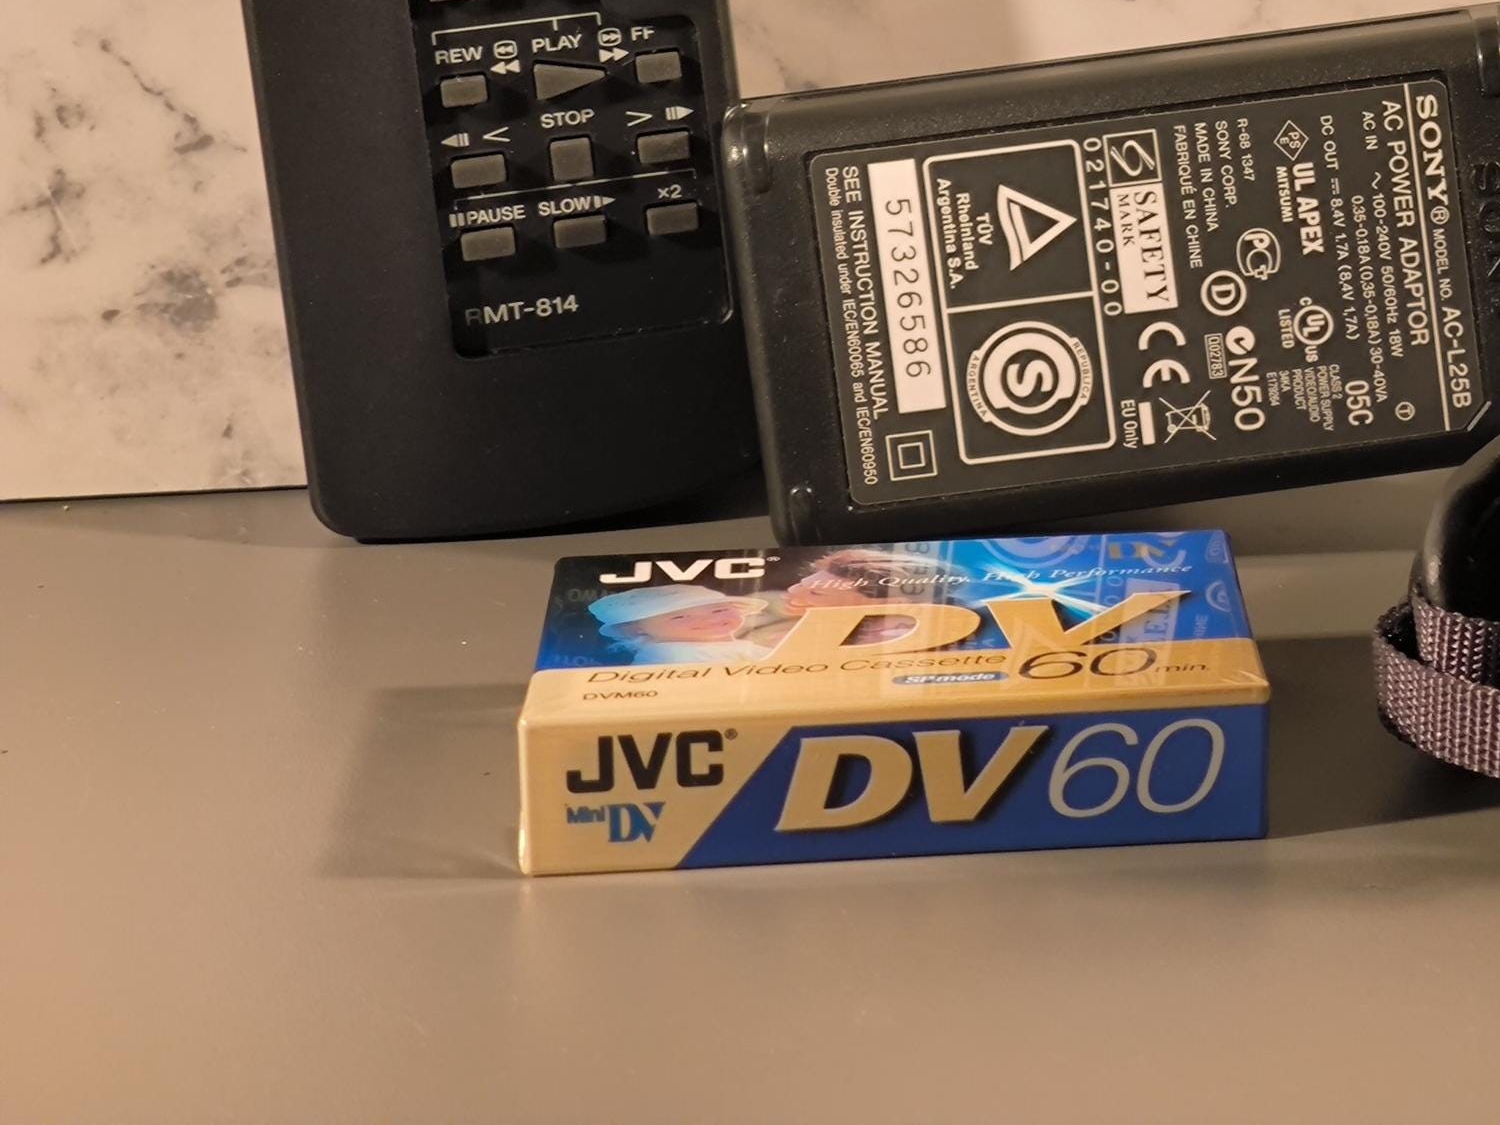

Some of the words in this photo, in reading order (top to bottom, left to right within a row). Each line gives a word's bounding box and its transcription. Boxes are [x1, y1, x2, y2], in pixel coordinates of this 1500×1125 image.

[532, 35, 582, 53] PLAY
[631, 27, 654, 41] FF
[435, 46, 482, 64] REW
[541, 109, 595, 128] STOP
[1237, 119, 1251, 149] R-68
[1320, 115, 1334, 135] DC
[1361, 111, 1375, 130] AC
[1382, 100, 1403, 131] AC
[1194, 123, 1209, 163] MADE
[1215, 120, 1231, 160] SONY
[1324, 140, 1338, 170] OUT
[1365, 135, 1377, 150] IN
[1173, 125, 1195, 195] FABRIQUÉ
[1200, 169, 1213, 183] IN
[1241, 153, 1255, 181] 1347
[1292, 162, 1316, 191] UL
[825, 167, 842, 206] Double
[842, 165, 861, 201] SEE
[1221, 165, 1237, 208] CORP.
[1276, 166, 1293, 222] MITSUMI
[1386, 141, 1414, 227] POWER
[468, 206, 526, 224] PAUSE
[538, 196, 591, 215] SLOW
[1117, 194, 1135, 246] MARK
[1182, 200, 1195, 220] EN
[1202, 187, 1218, 232] CHINA
[1329, 198, 1347, 227] 8.4V
[830, 210, 845, 259] insulated
[936, 178, 960, 253] Argentina
[948, 257, 963, 289] S.A.
[956, 193, 978, 270] Rheinland
[975, 212, 993, 246] TÜV
[1296, 197, 1324, 255] APEX
[1372, 193, 1391, 260] 100-240V
[1134, 191, 1169, 303] SAFETY
[1184, 226, 1202, 268] CHINE
[1335, 232, 1351, 260] 1.7A
[1432, 229, 1448, 274] MODEL
[837, 263, 851, 294] under
[848, 211, 878, 334] INSTRUCTION
[885, 197, 932, 379] 57326586
[1398, 237, 1429, 345] ADAPTOR
[1438, 278, 1452, 300] NO.
[465, 295, 579, 327] RMT-814
[1379, 265, 1398, 324] 50/60Hz
[842, 299, 862, 378] IEC/EN60065
[1278, 309, 1295, 348] LISTED
[1388, 329, 1403, 357] 18W
[1071, 340, 1091, 401] REPUBLICA
[1369, 347, 1388, 402] 30-40VA
[1442, 307, 1471, 408] AC-L25B
[852, 382, 865, 403] and
[865, 342, 889, 420] MANUAL
[968, 354, 987, 418] ARGENTINA
[1292, 369, 1306, 410] PRODUCT
[1304, 367, 1320, 422] VIDEO/AUDIO
[1317, 366, 1329, 398] POWER
[1329, 364, 1342, 392] CLASS
[1120, 399, 1136, 418] EU
[1320, 399, 1334, 431] SUPPLY
[1345, 380, 1374, 426] 05C
[855, 406, 878, 484] IEC/EN60950
[1122, 422, 1139, 449] Only
[810, 577, 869, 590] High
[1043, 564, 1193, 580] Performance
[587, 667, 712, 684] Digital
[724, 662, 829, 676] Video
[839, 656, 1007, 672] Cassette
[1018, 647, 1158, 680] 60
[582, 690, 658, 701] DVM60
[773, 724, 1050, 834] DV
[1046, 718, 1226, 820] 60
[606, 801, 667, 843] DV
